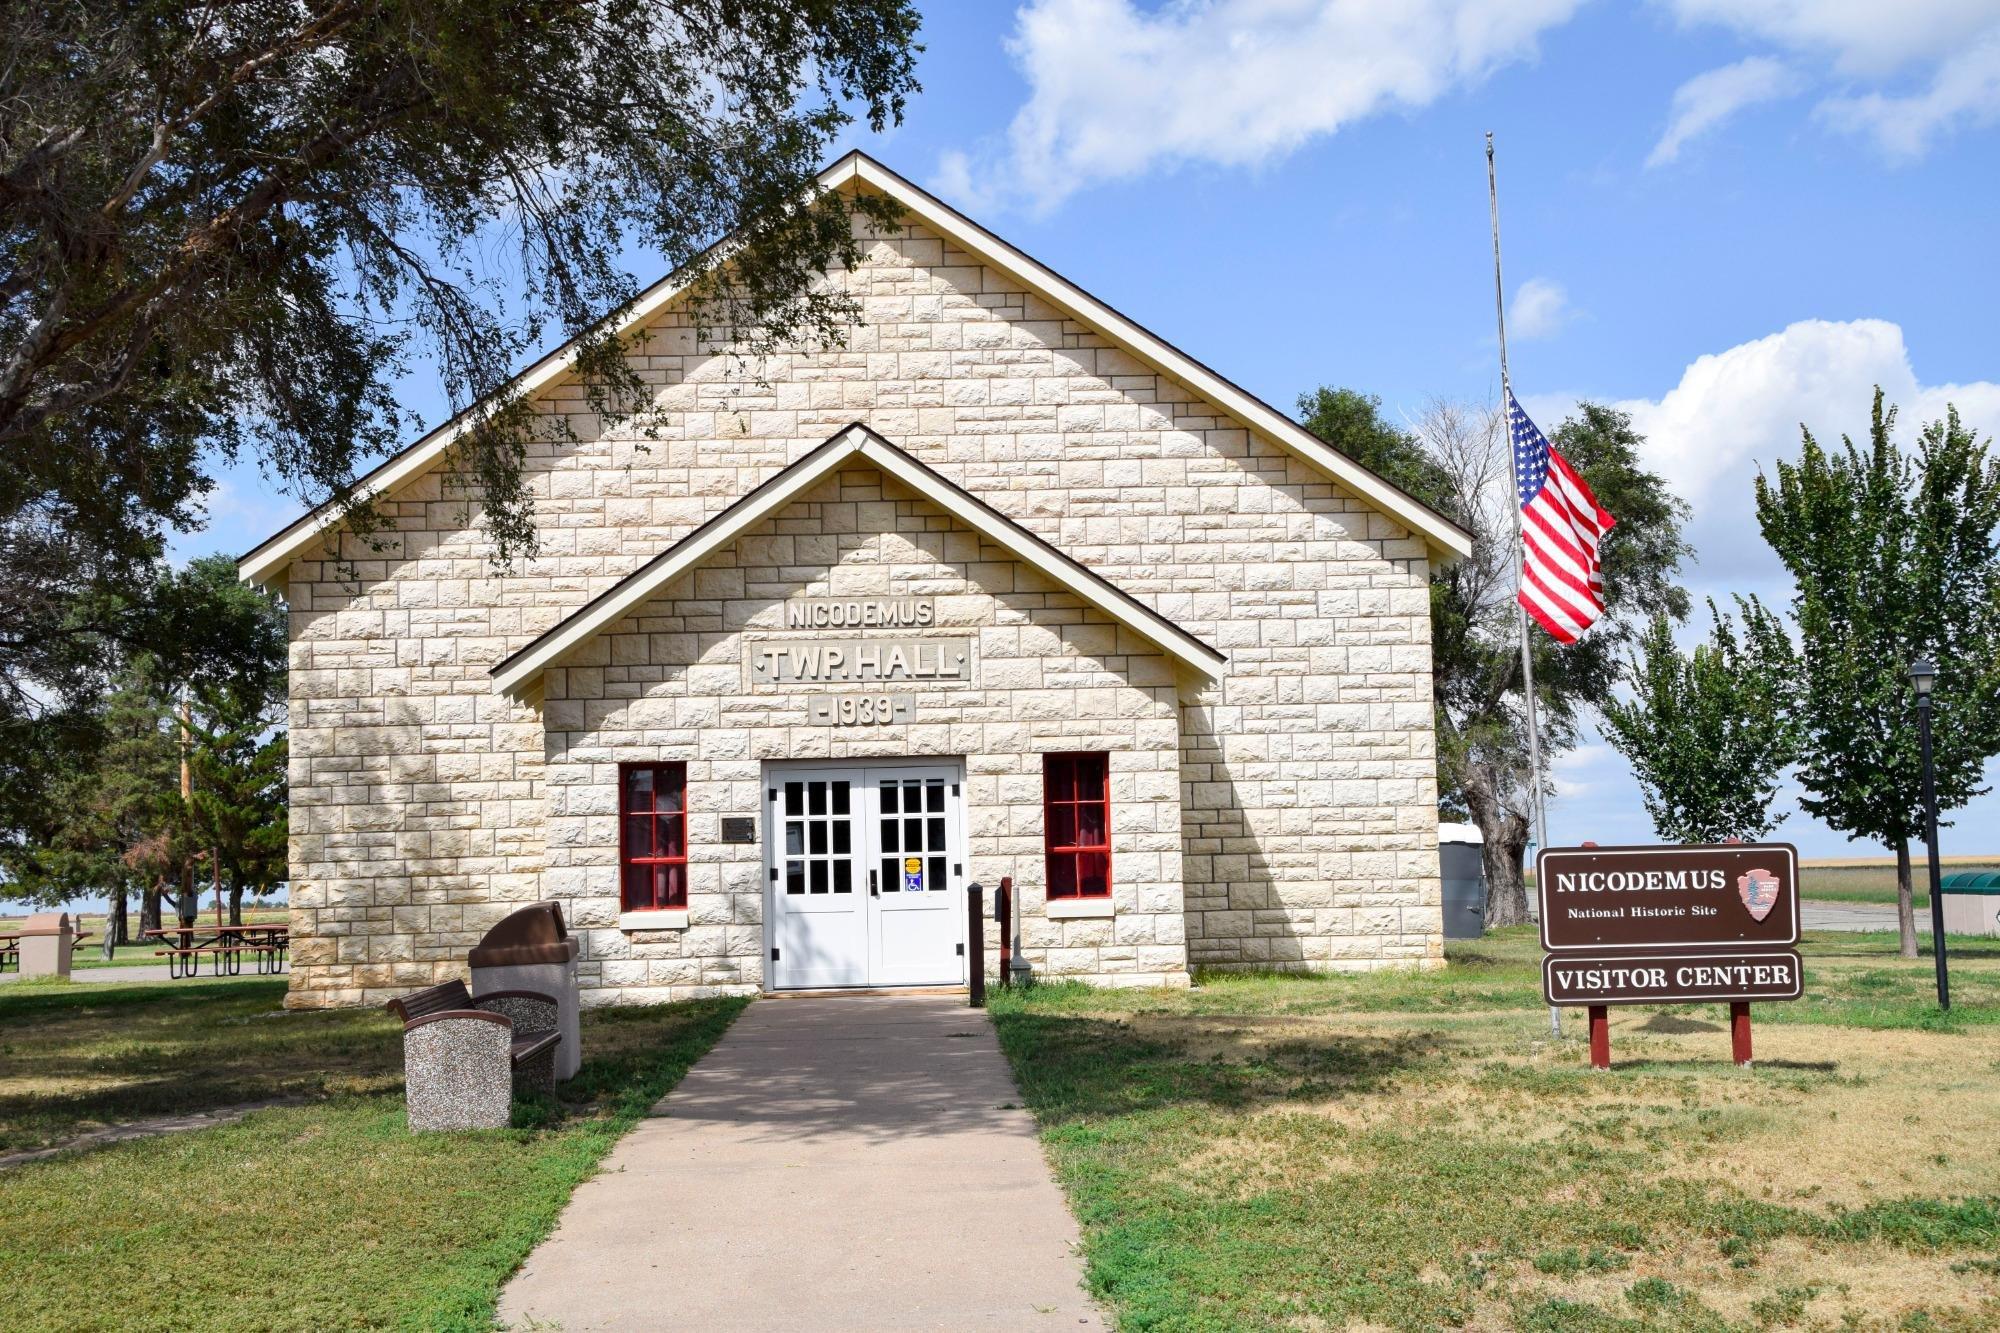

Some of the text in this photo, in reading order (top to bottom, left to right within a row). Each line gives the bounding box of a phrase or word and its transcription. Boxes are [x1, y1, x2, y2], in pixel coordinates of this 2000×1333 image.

[789, 601, 933, 627] NICODEMUS
[762, 644, 960, 679] TWP. HALL
[1556, 869, 1726, 893] NICODEMUS
[1567, 905, 1717, 919] National Historic Site
[1556, 965, 1791, 990] VISITOR CENTER
